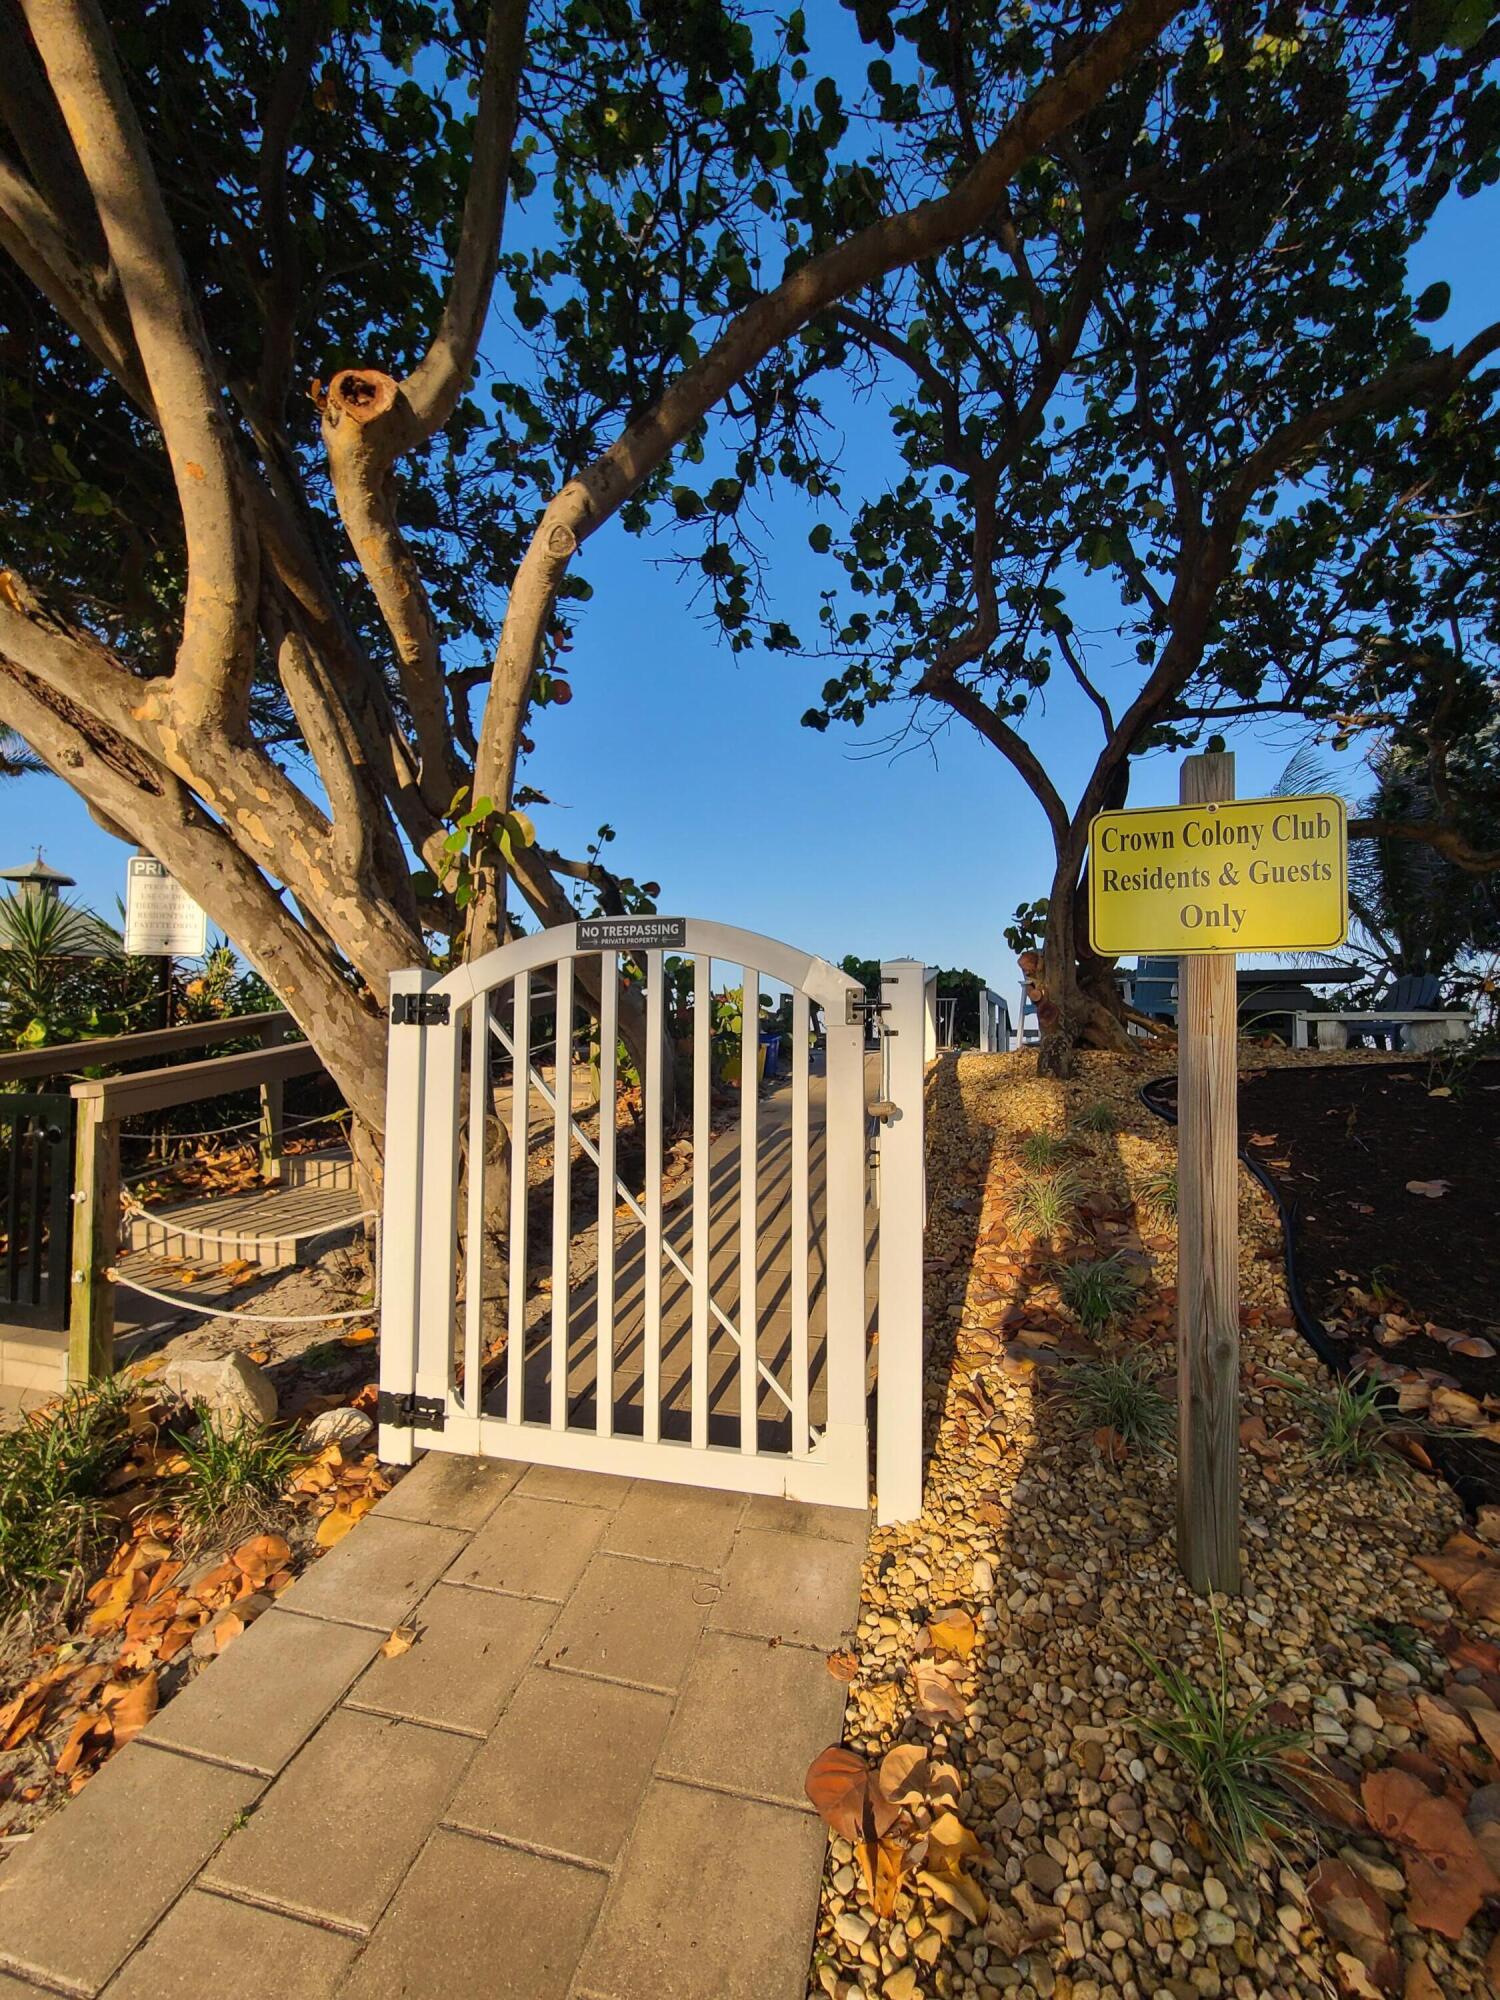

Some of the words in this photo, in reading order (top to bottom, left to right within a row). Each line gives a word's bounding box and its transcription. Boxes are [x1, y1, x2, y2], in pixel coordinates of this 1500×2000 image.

[1101, 827, 1175, 853] Crown
[1182, 821, 1264, 850] Colony
[1272, 812, 1331, 841] Club
[134, 862, 164, 875] PRI
[1102, 866, 1211, 892] Residents
[1218, 861, 1240, 886] &
[1249, 858, 1332, 885] Guests
[1180, 903, 1247, 933] Only
[581, 926, 600, 938] NO
[602, 923, 680, 938] TRESPASSING
[627, 936, 658, 944] PROPERTY
